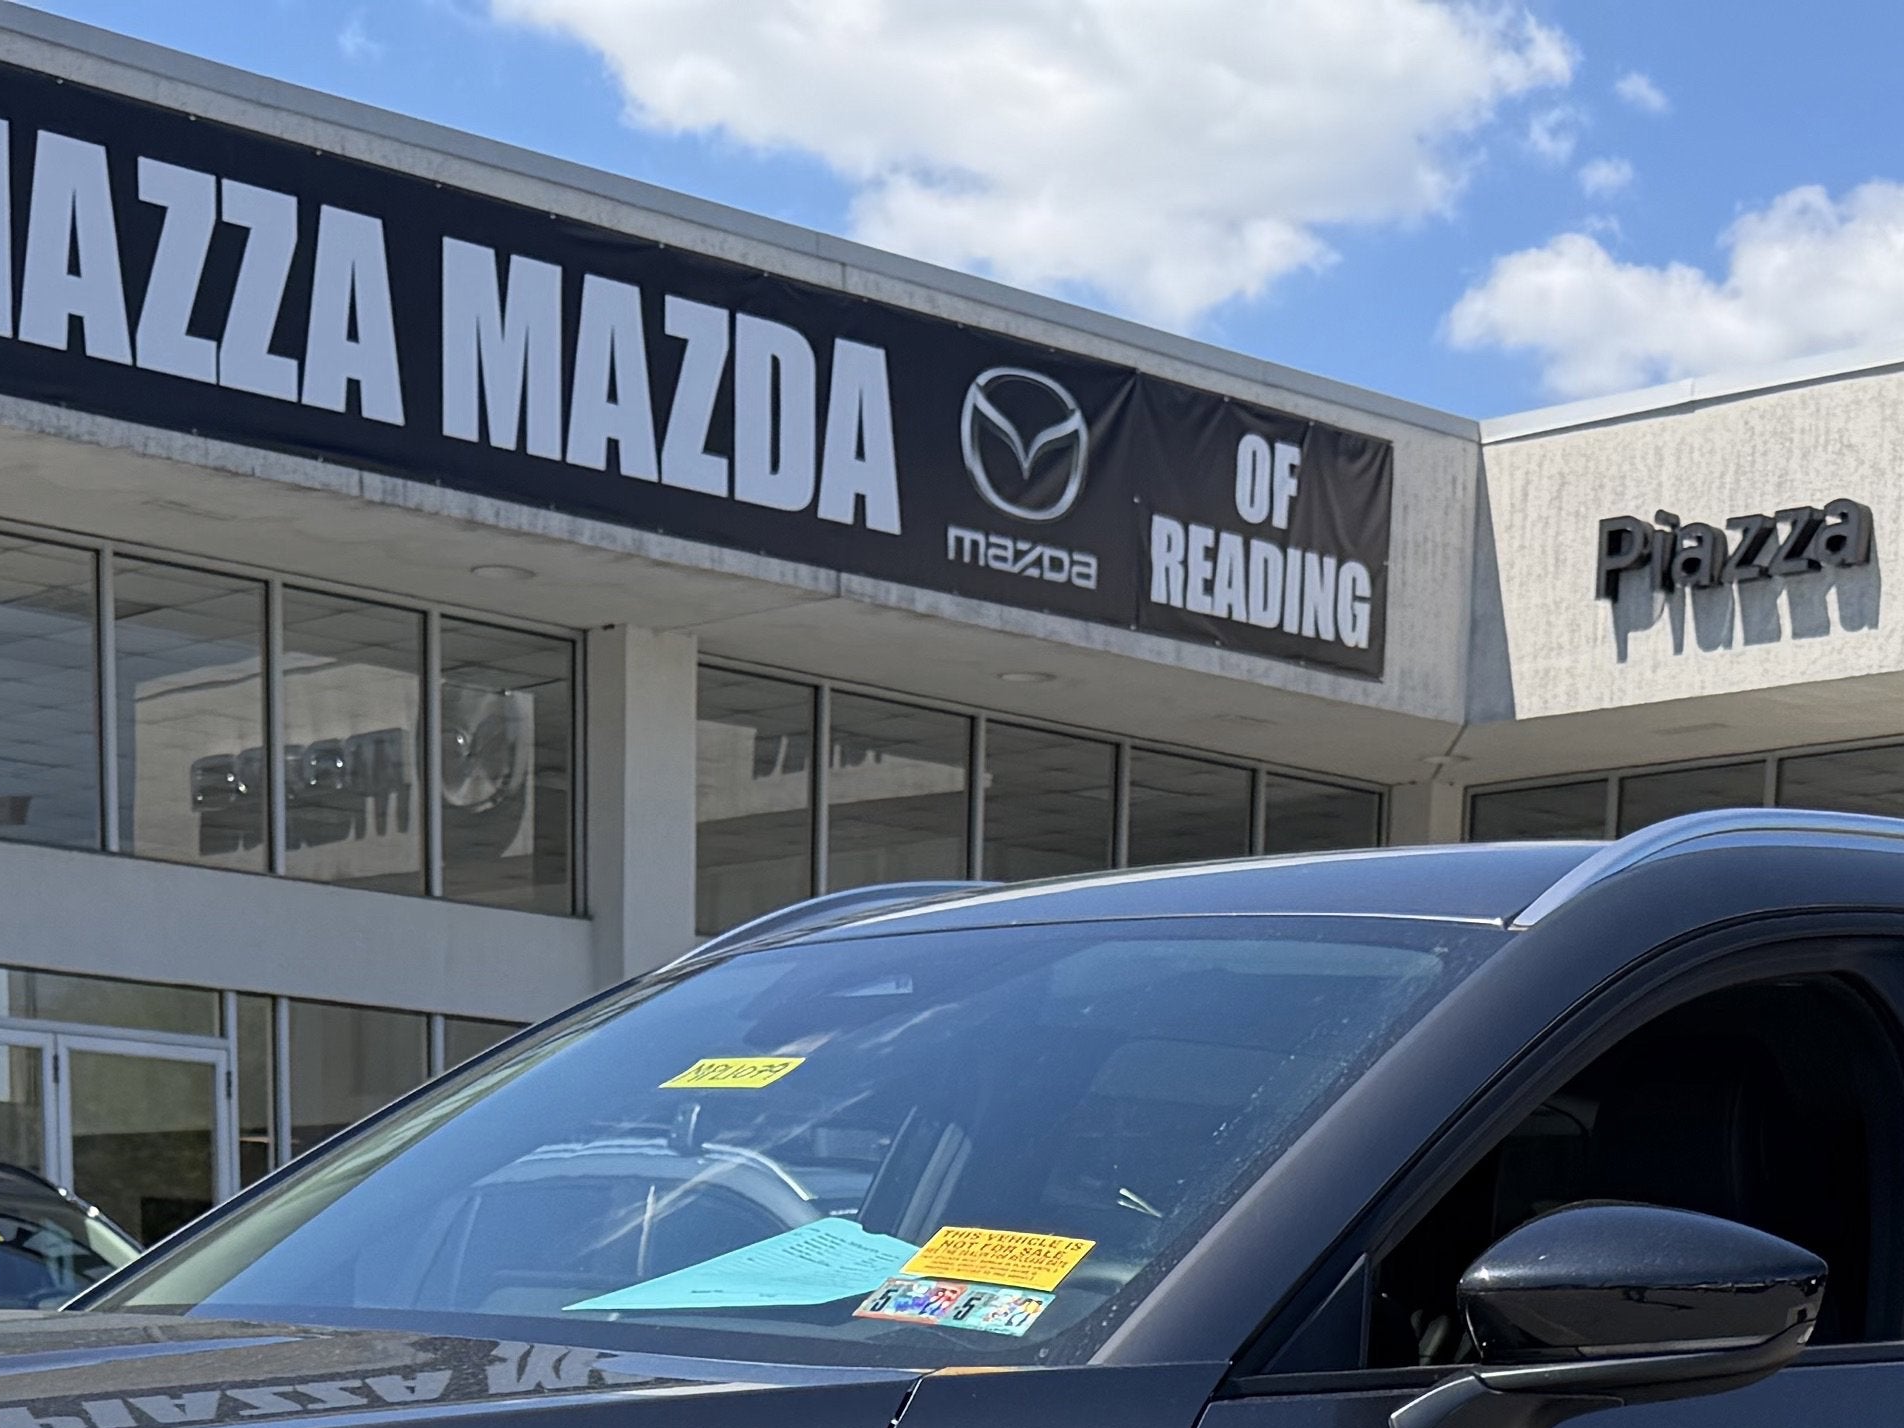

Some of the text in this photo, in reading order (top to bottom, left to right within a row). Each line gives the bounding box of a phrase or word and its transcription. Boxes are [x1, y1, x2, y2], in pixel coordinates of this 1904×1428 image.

[441, 236, 901, 535] MAZDA
[1236, 435, 1302, 527] OF
[946, 525, 1098, 589] mazda
[1596, 496, 1872, 602] Piazza
[1150, 514, 1370, 650] READING
[939, 1240, 976, 1251] NOT
[981, 1242, 1016, 1254] FOR
[1019, 1247, 1066, 1261] SALE
[942, 1229, 1084, 1251] THIS VEHICLE IS
[871, 1288, 898, 1312] 5
[954, 1296, 981, 1321] 5
